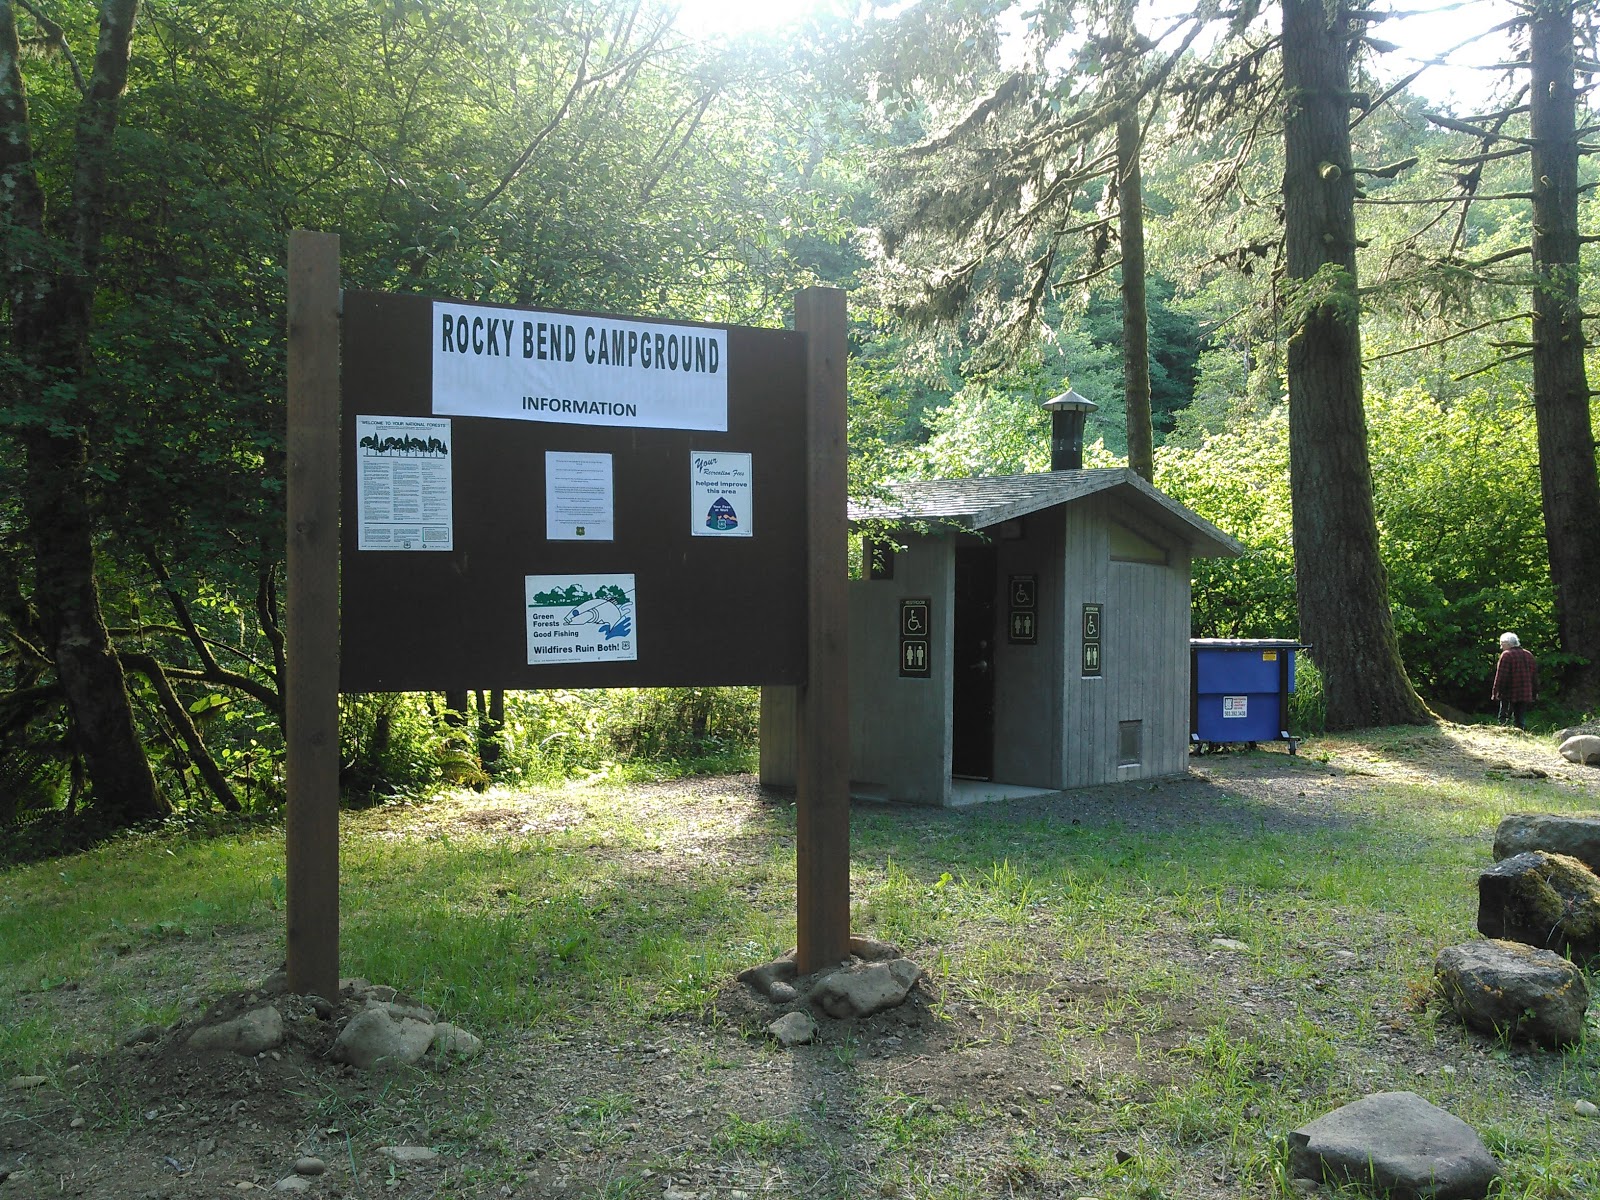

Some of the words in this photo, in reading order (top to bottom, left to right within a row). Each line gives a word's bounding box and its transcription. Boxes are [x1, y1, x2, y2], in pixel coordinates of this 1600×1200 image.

[443, 314, 514, 357] ROCKY
[523, 321, 576, 362] BEND
[584, 326, 719, 374] CAMPGROUND
[522, 396, 637, 417] INFORMATION
[694, 458, 718, 472] Your
[534, 646, 572, 654] Wildfires
[576, 644, 594, 652] Ruin
[598, 643, 620, 652] Both!
